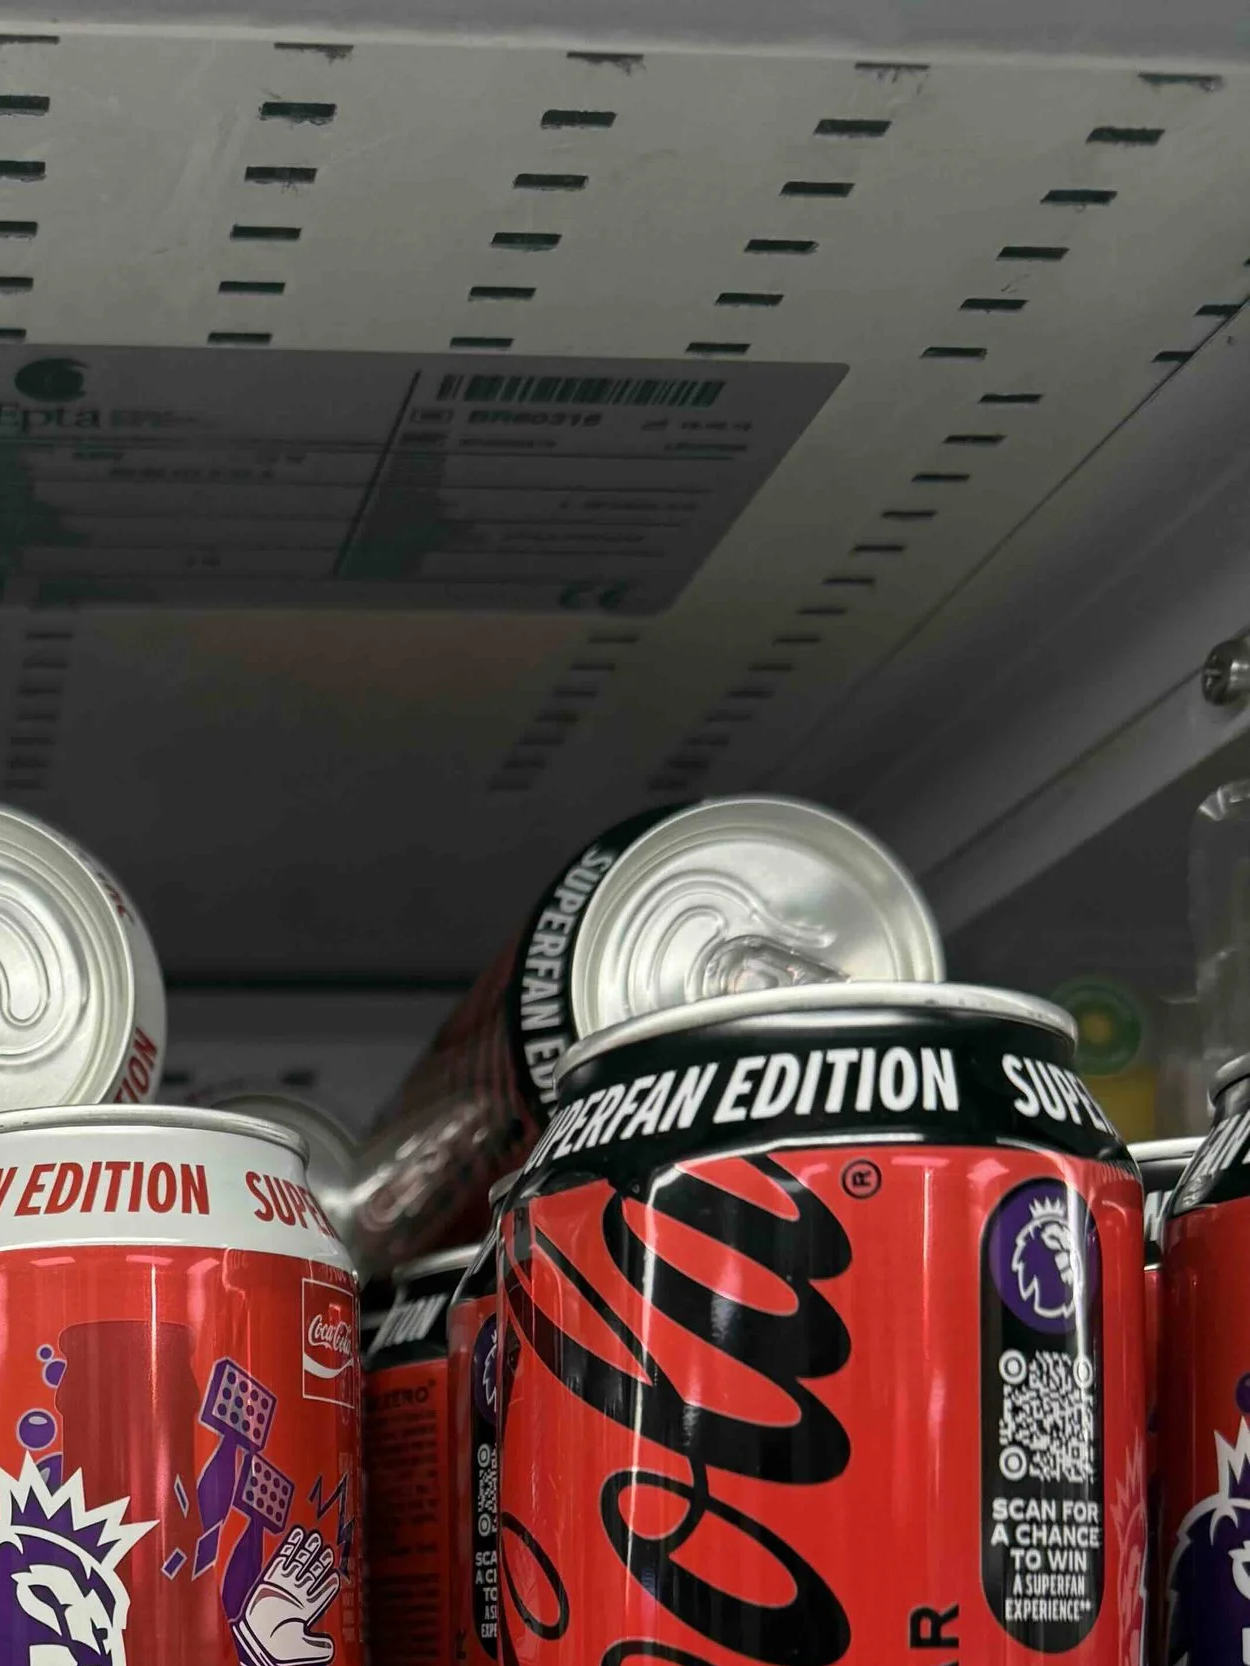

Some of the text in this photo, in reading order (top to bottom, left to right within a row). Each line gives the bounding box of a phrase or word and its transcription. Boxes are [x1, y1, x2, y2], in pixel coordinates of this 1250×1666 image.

[520, 846, 613, 1030] SUPERFAN
[525, 1062, 718, 1170] UPERFAN
[712, 1046, 959, 1125] EDITION
[14, 1161, 210, 1217] EDITION
[992, 1497, 1099, 1523] SCAN FOR
[990, 1522, 1100, 1548] A CHANCE
[475, 1550, 497, 1566] SCA
[1010, 1548, 1087, 1573] TO WIN
[1013, 1573, 1085, 1597] A SUPERFAN
